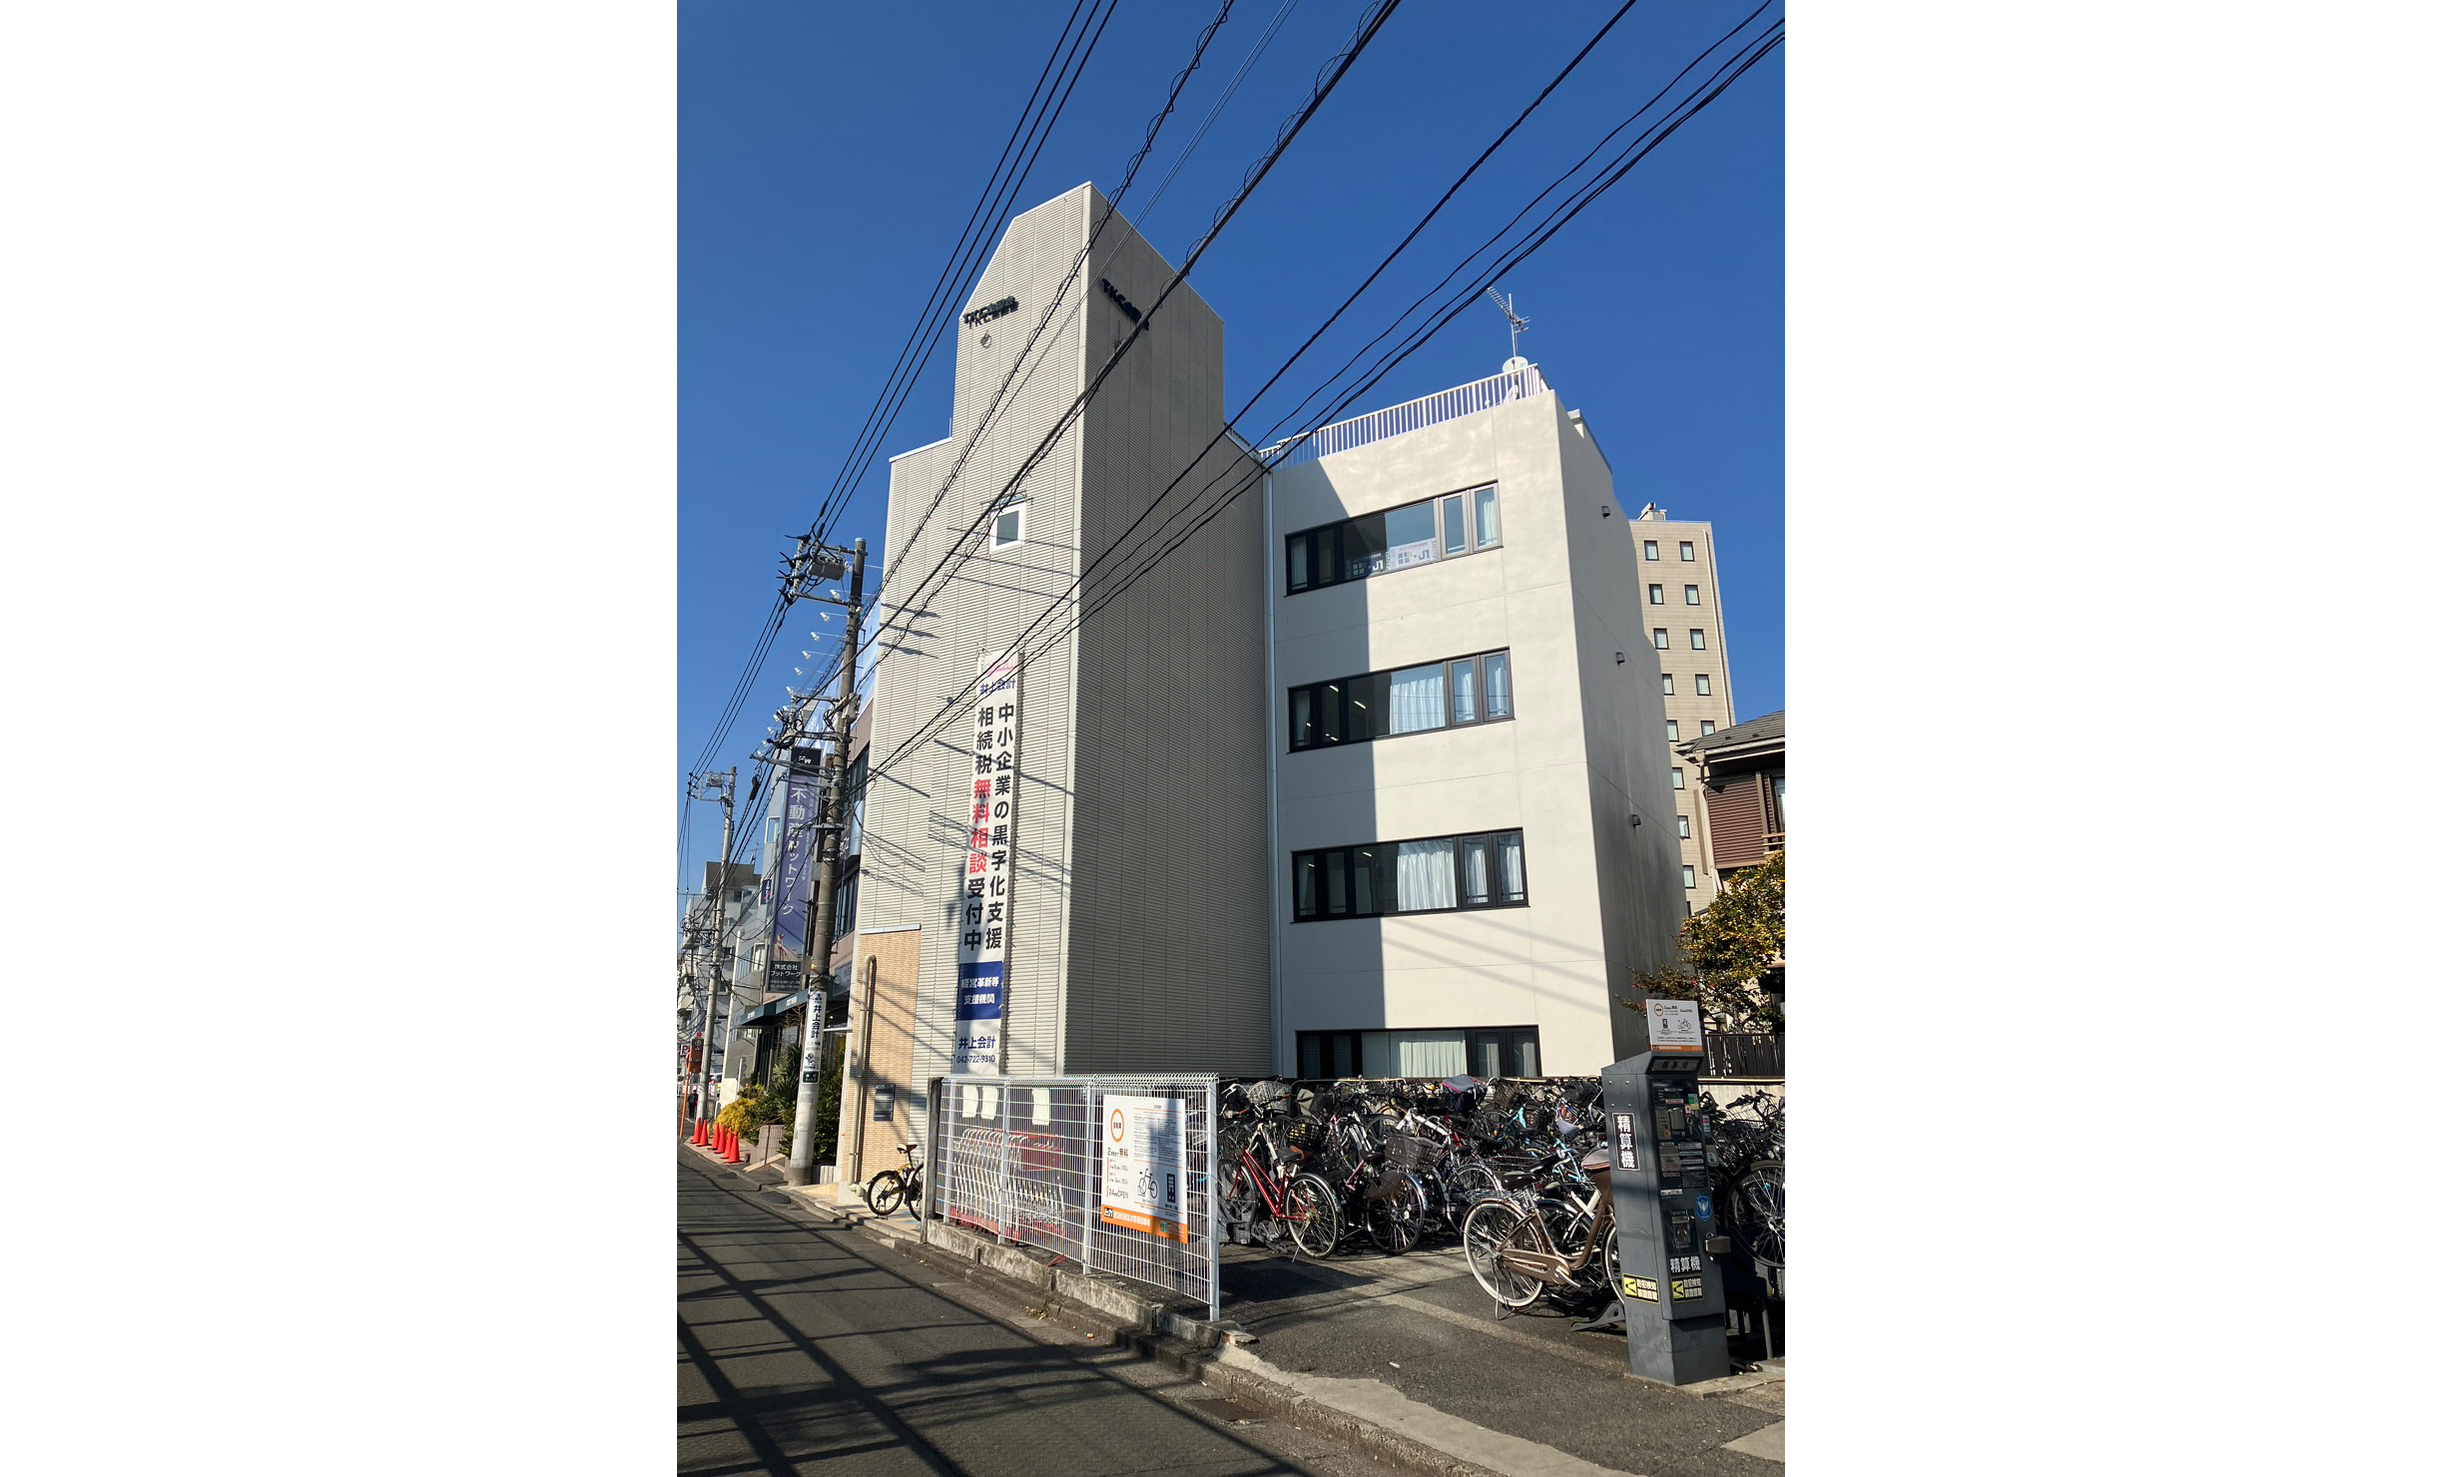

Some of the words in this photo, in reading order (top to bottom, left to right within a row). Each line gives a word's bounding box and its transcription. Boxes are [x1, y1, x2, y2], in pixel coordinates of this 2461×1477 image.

[985, 703, 1014, 950] 中小企業の黒字化支援
[811, 1004, 823, 1039] 井上会計
[958, 1036, 996, 1050] 井上会計
[1617, 1115, 1635, 1168] 精算機
[1669, 1256, 1701, 1273] 精算機
